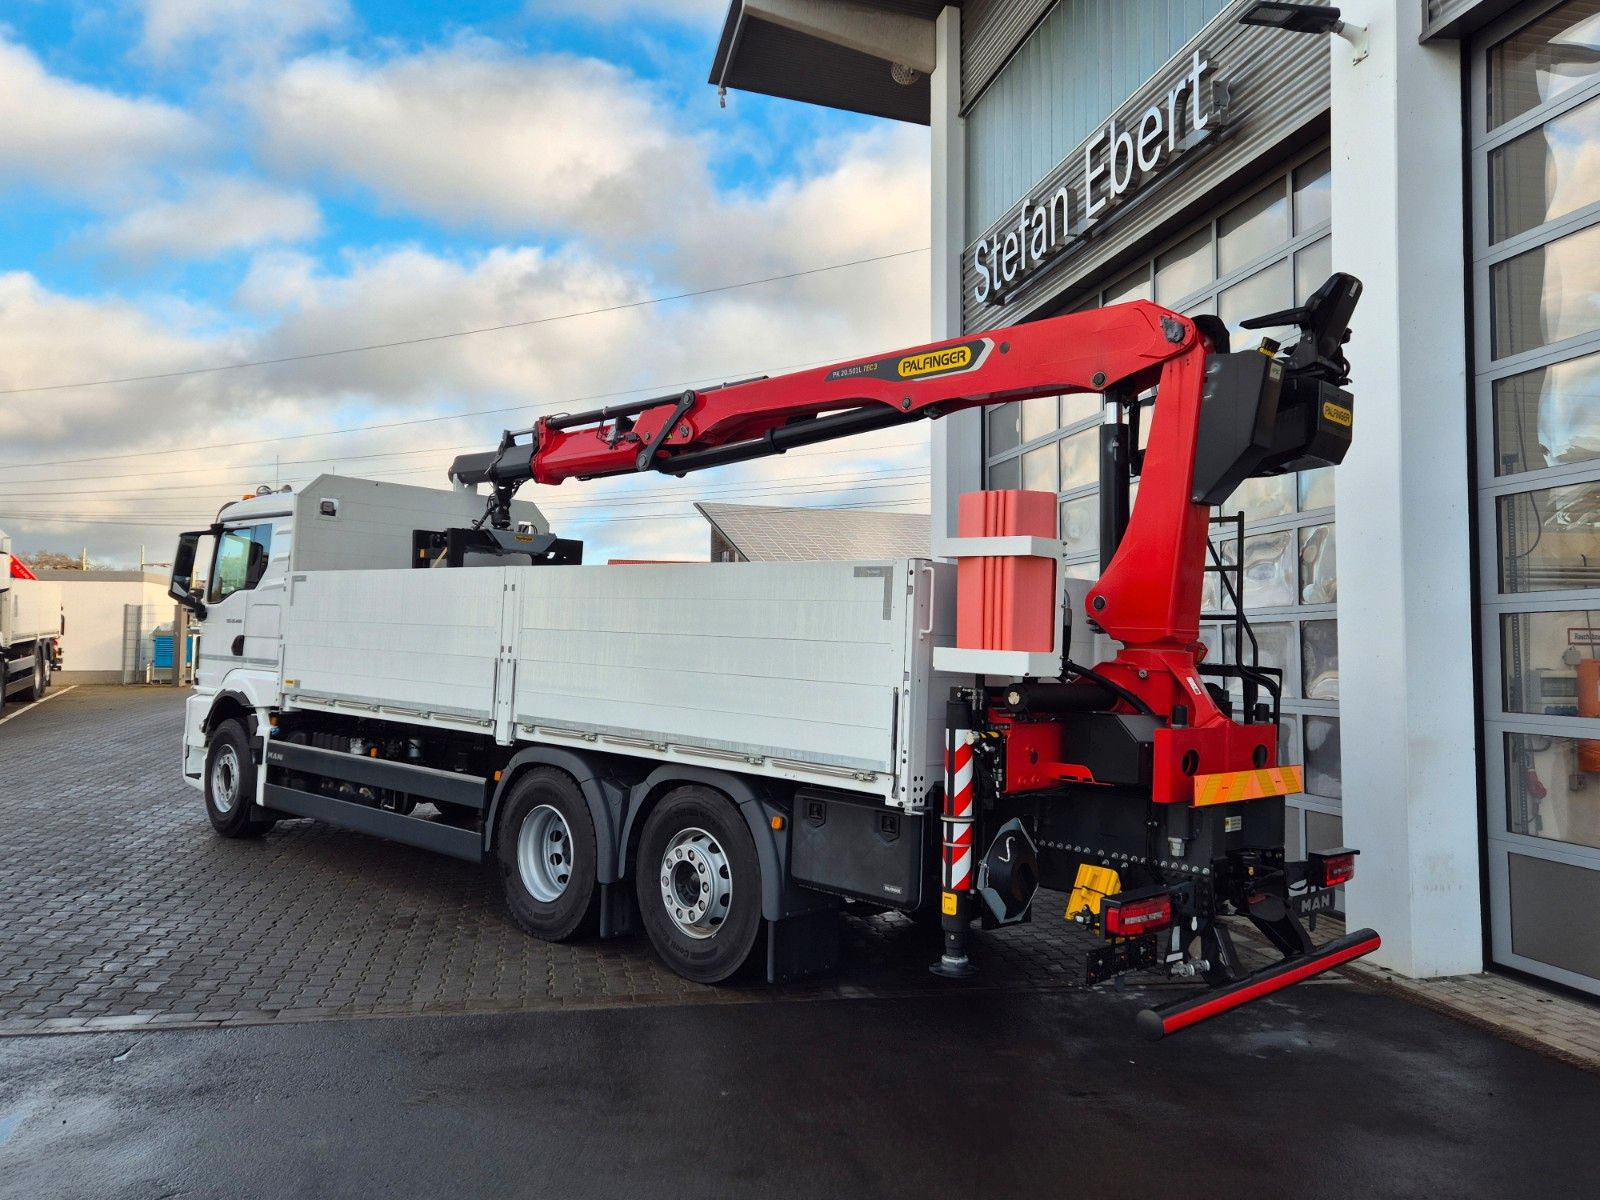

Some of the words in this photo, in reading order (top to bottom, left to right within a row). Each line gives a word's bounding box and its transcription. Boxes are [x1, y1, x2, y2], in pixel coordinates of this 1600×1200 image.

[974, 186, 1069, 304] Stefan
[1085, 50, 1209, 220] Ebert
[902, 349, 967, 373] PALFINGER
[1325, 405, 1350, 423] PALFINGER
[267, 751, 284, 761] MAN
[1301, 894, 1330, 913] MAN
